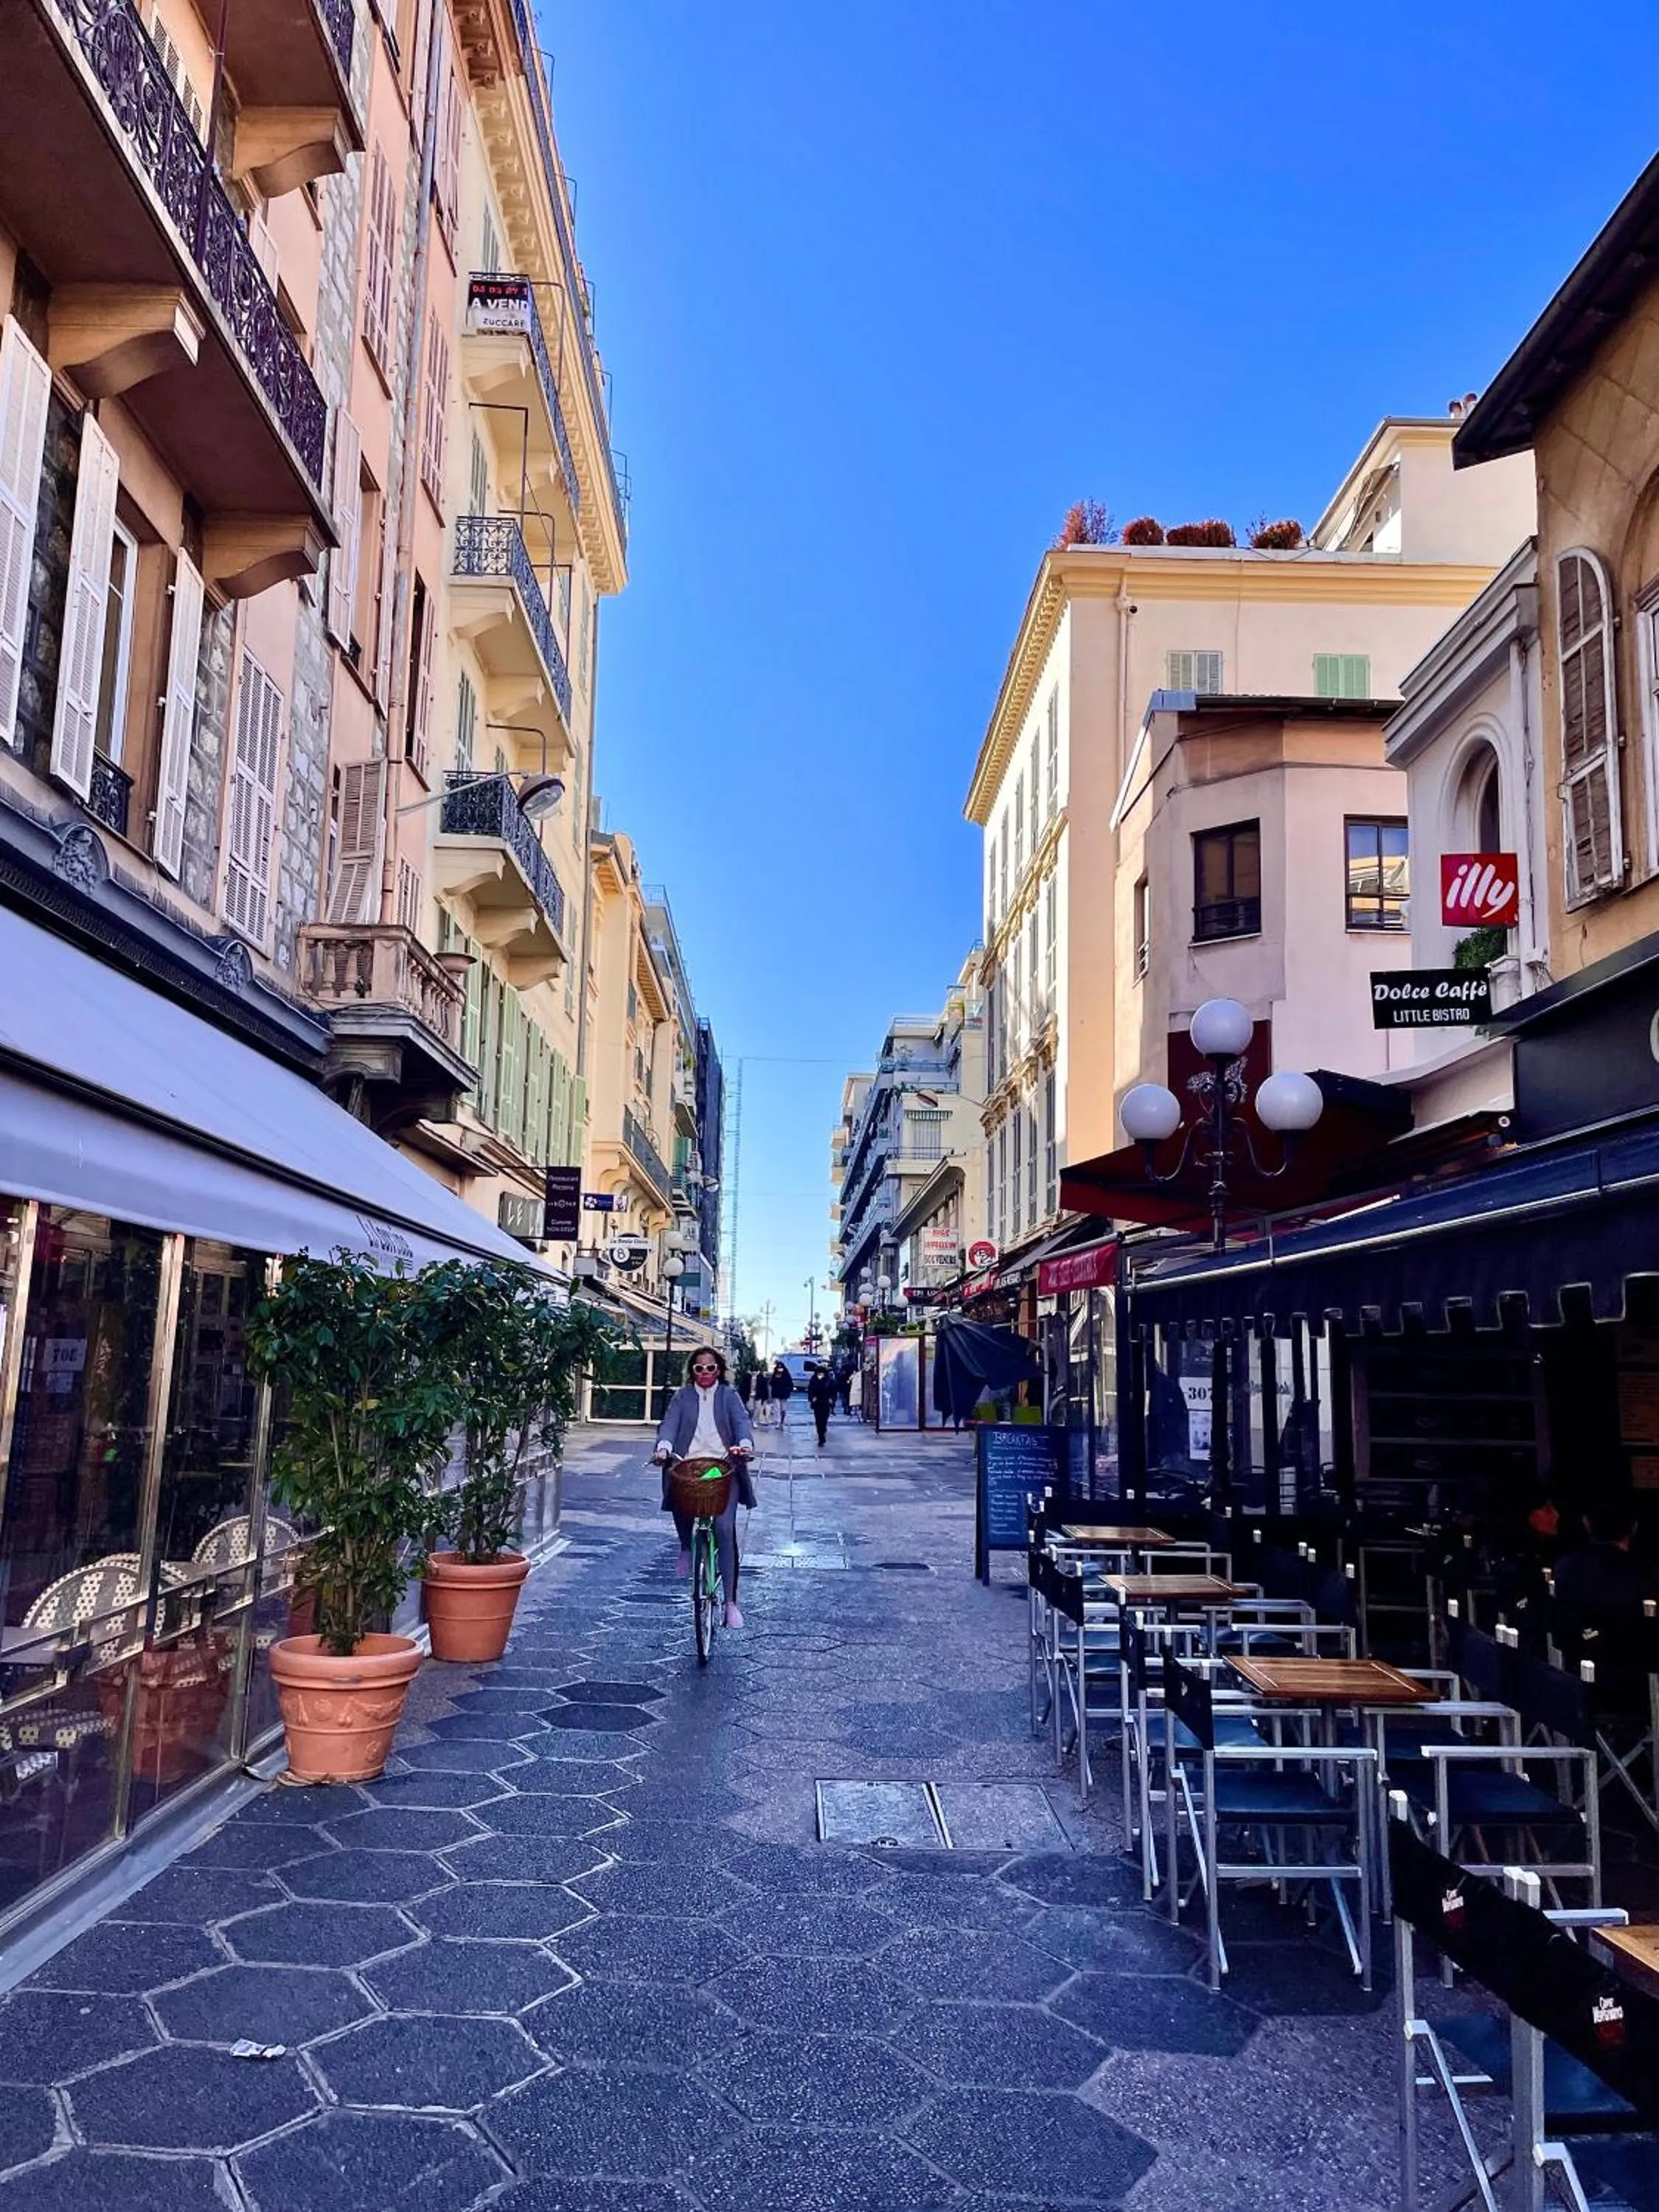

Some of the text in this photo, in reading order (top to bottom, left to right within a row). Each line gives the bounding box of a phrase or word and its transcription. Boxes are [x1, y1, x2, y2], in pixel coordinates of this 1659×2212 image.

[1446, 862, 1515, 919] illy
[1374, 981, 1487, 1001] Dolce Caffè
[1394, 1008, 1470, 1023] LITTLE BISTRO
